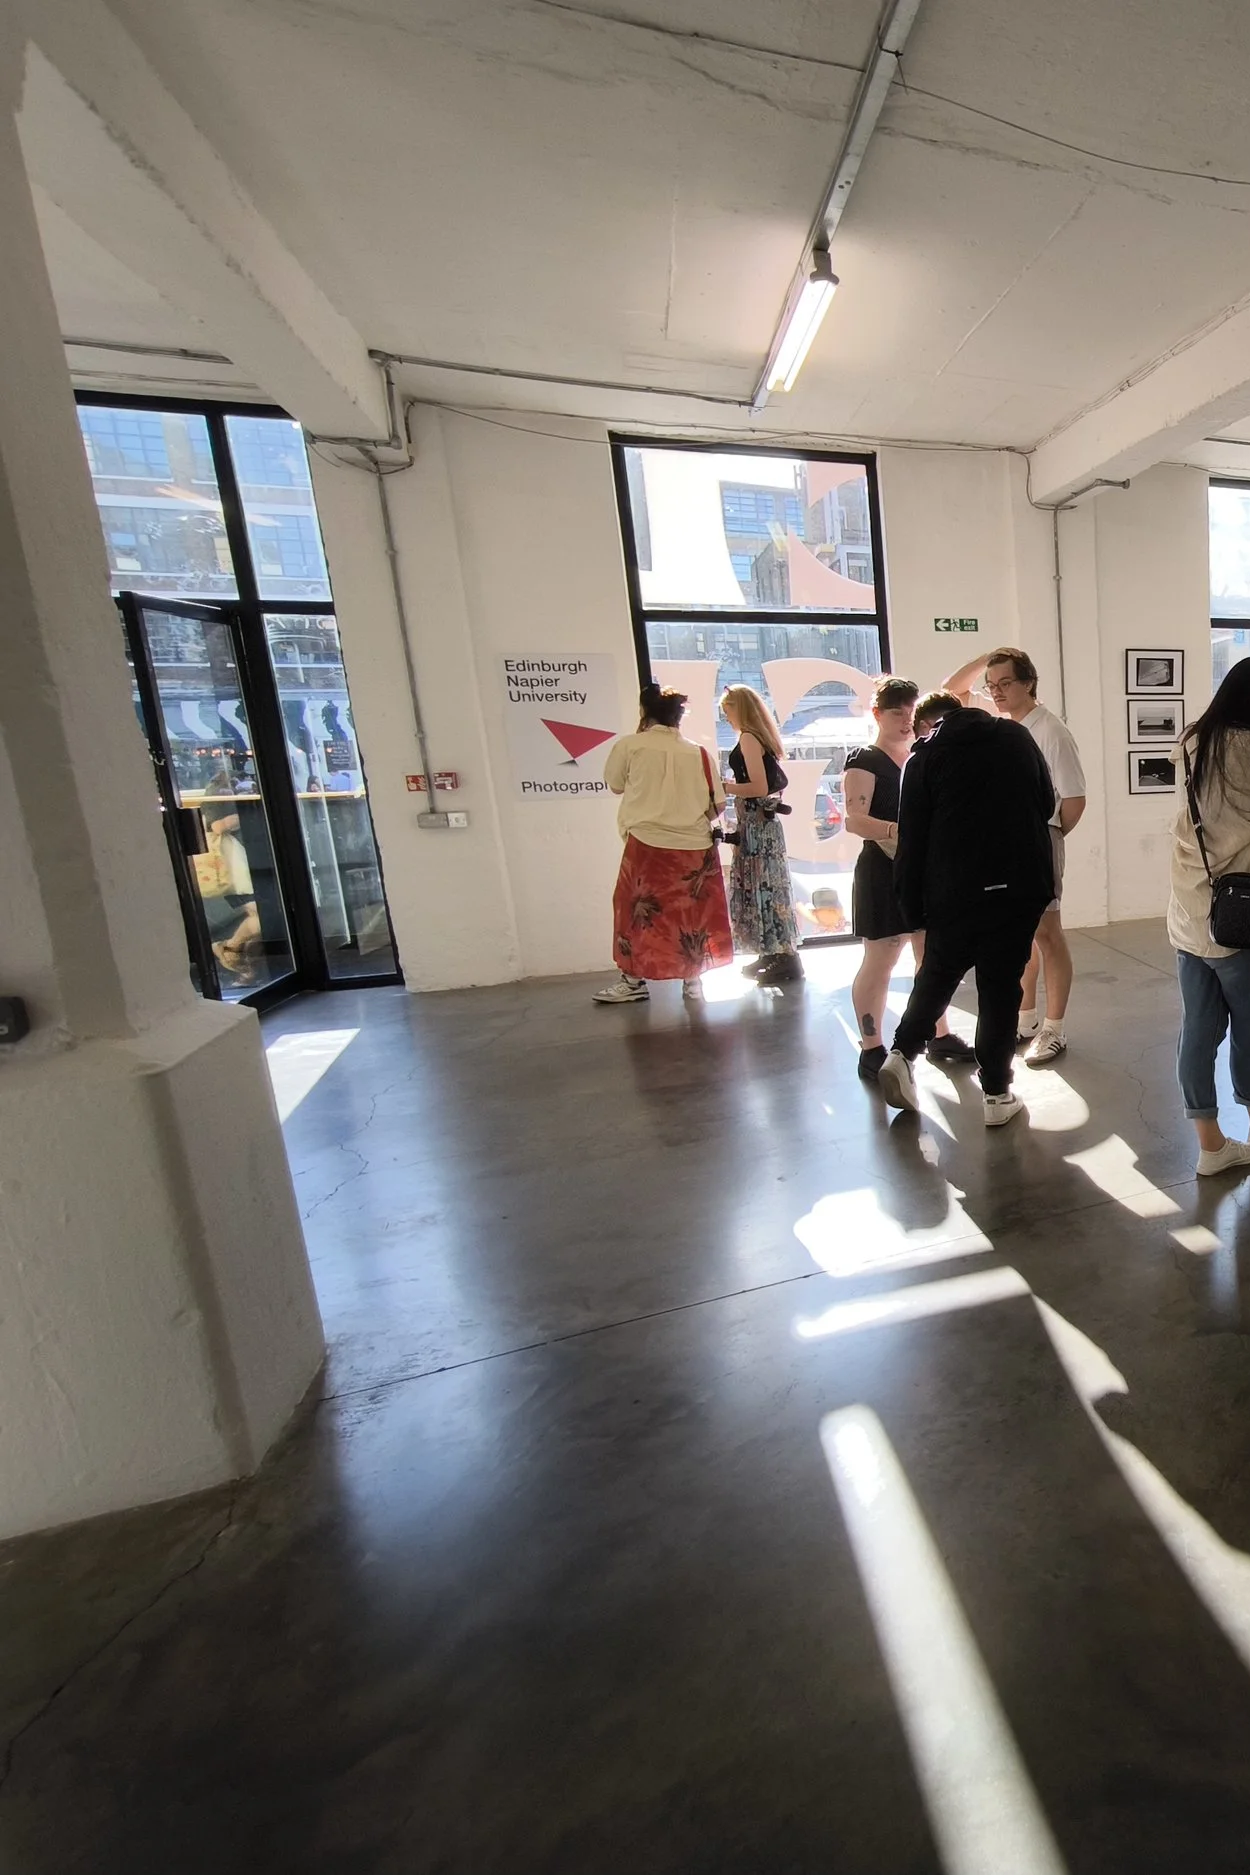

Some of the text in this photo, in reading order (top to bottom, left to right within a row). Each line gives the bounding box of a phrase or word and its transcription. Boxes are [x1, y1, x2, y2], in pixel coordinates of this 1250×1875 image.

[504, 659, 588, 675] Edinburgh
[506, 675, 560, 689] Napier
[508, 690, 588, 705] University
